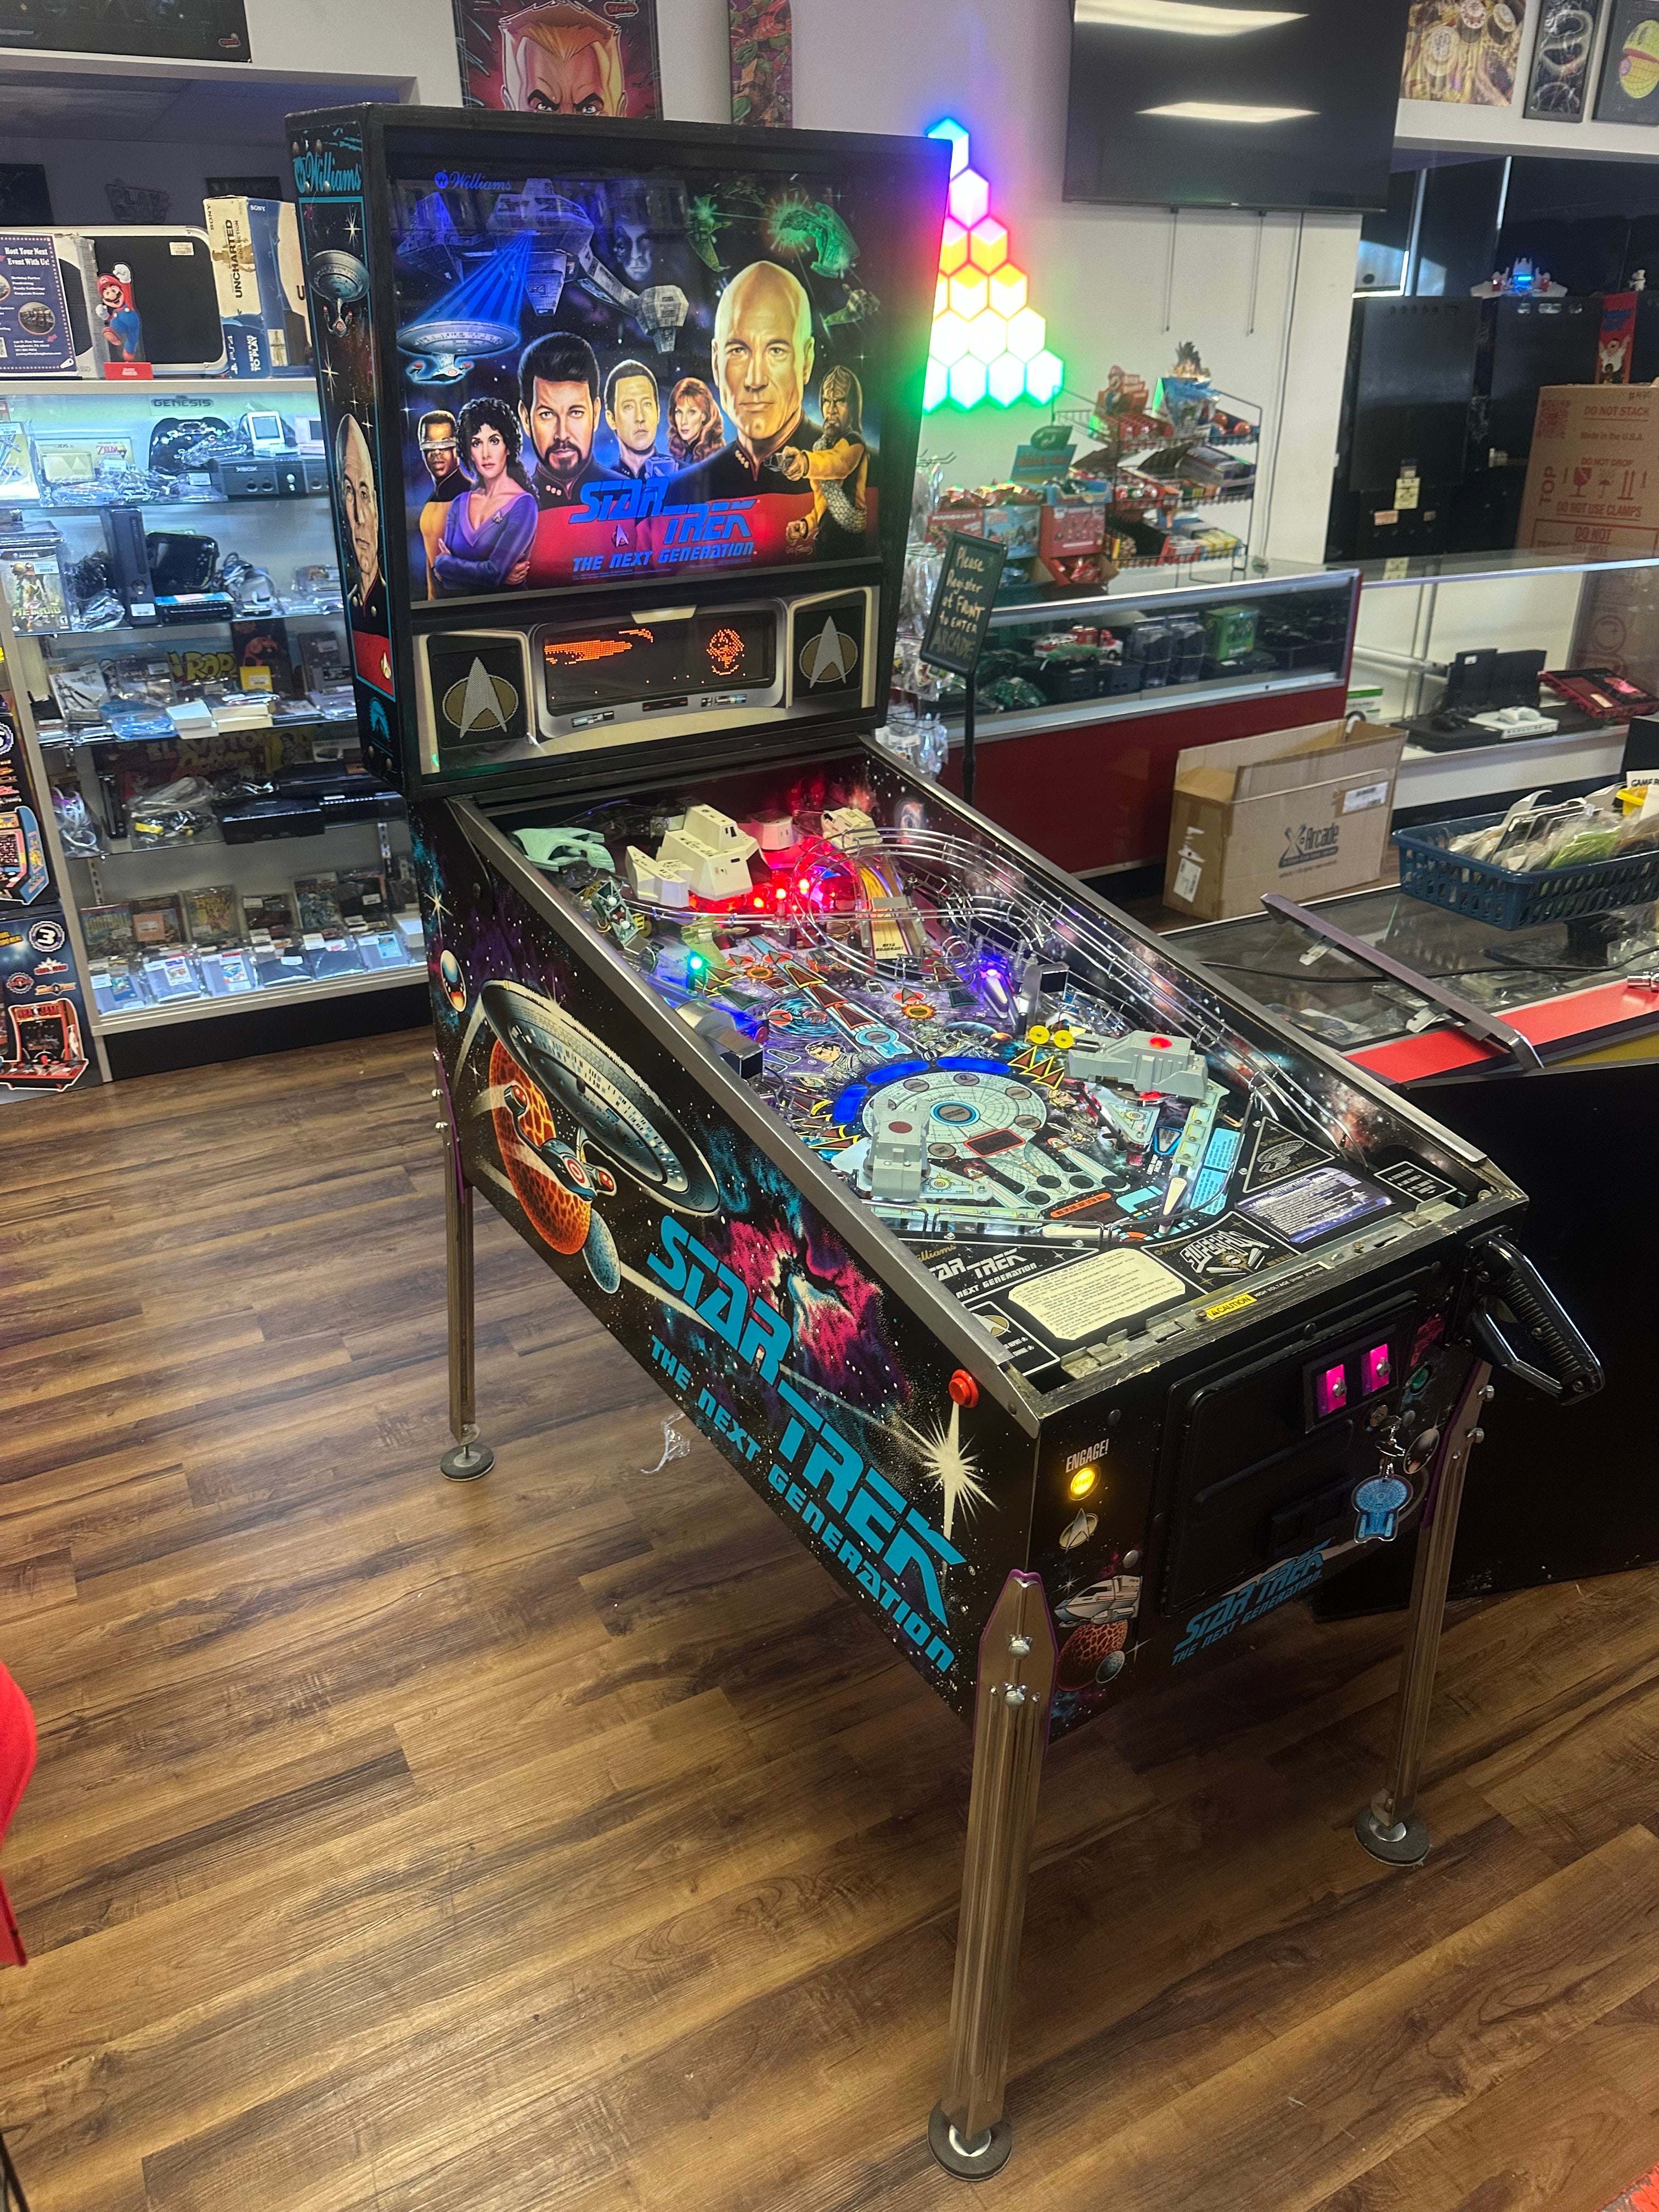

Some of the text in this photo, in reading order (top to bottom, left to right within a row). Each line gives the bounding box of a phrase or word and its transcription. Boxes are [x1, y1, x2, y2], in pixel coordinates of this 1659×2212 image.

[305, 151, 362, 191] Williams
[449, 171, 512, 190] Williams
[206, 204, 215, 230] SONY
[4, 247, 19, 255] Host
[225, 219, 243, 298] UNCHARTED
[1584, 406, 1650, 416] DO NOT STACK
[569, 476, 670, 524] STAR
[1539, 466, 1556, 506] TOP
[661, 499, 758, 545] TREK
[1556, 501, 1644, 517] DO NOT USE CLAMPS
[1575, 526, 1613, 541] DO NOT
[572, 554, 605, 572] THE
[609, 550, 653, 569] NEXT
[658, 541, 755, 563] GENERATION
[956, 546, 985, 572] Please
[946, 569, 983, 595] Register
[939, 610, 978, 634] to ENTER
[38, 928, 55, 944] 3
[916, 1243, 957, 1262] illiams
[966, 1248, 1028, 1279] TREK
[956, 1262, 1037, 1299] NEXT GENERATION
[647, 1215, 793, 1390] STAR
[1215, 1296, 1252, 1313] CAUTION
[1254, 1289, 1268, 1298] HIGH
[1267, 1280, 1290, 1295] VOLTAGE
[1065, 1438, 1109, 1473] ENGAGE!
[1074, 1476, 1093, 1488] START
[649, 1334, 956, 1673] THE NEXT GENERATION
[778, 1379, 967, 1629] TREK
[1173, 1537, 1333, 1652] STAR TREK
[1171, 1569, 1323, 1667] THE NEXT GENERATION
